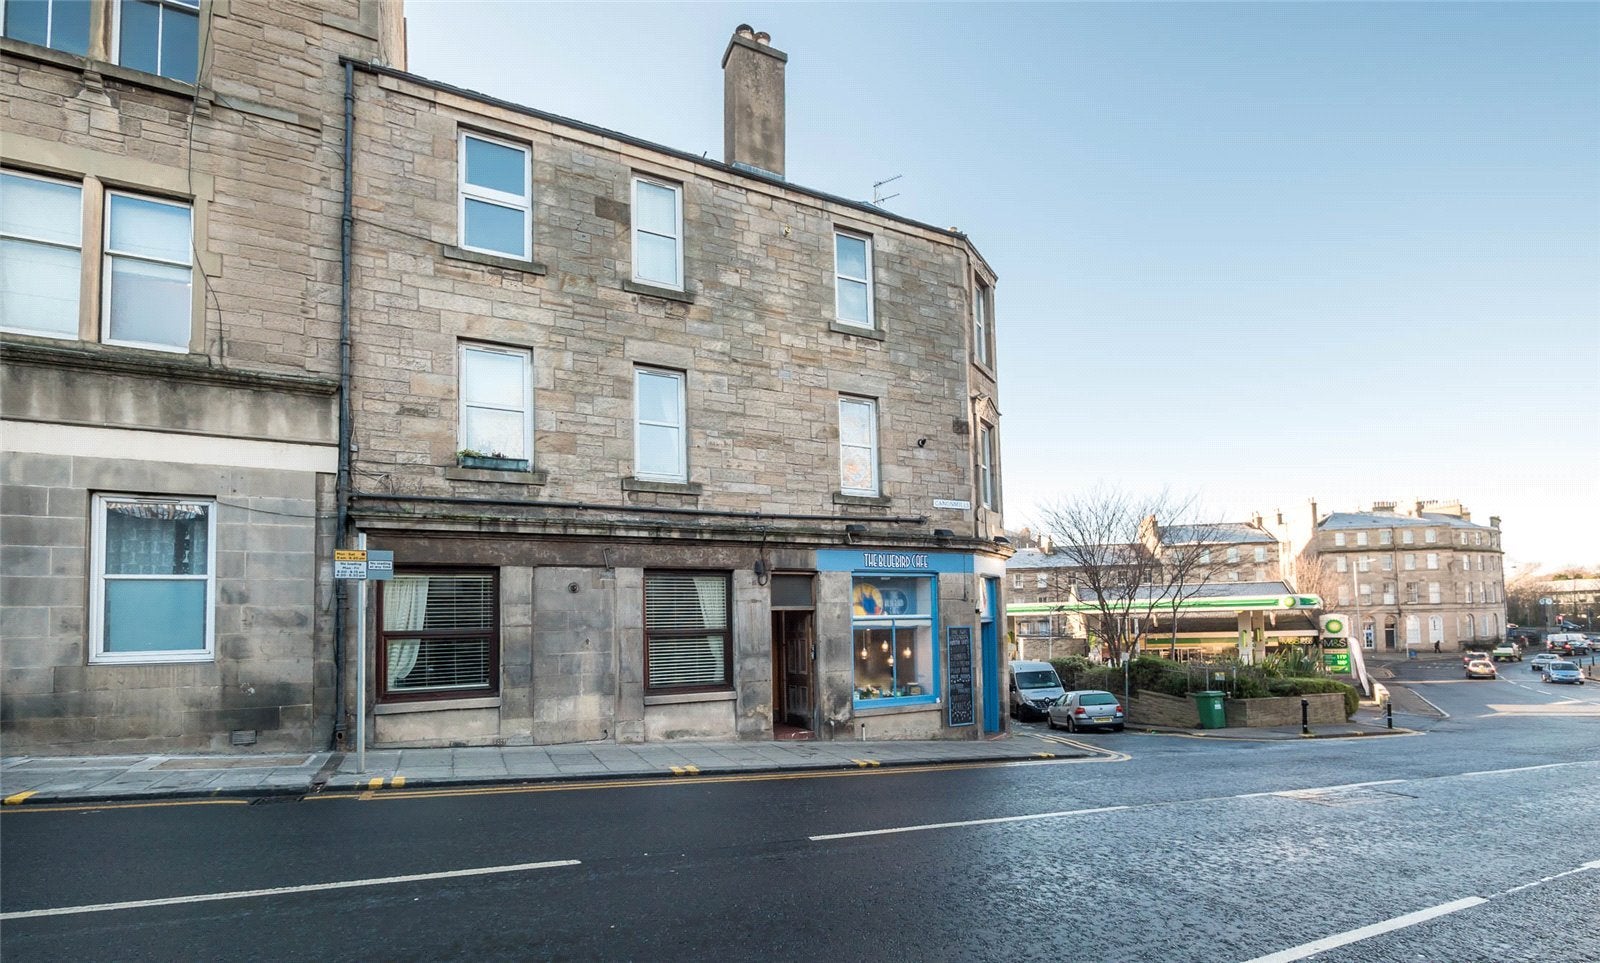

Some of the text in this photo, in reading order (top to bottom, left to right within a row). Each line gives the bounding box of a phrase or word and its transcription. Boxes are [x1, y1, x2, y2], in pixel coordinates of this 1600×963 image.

[935, 500, 969, 508] CANONMILLS
[864, 553, 928, 568] THE BLUEBIRD CAFE
[1323, 638, 1347, 648] M&S
